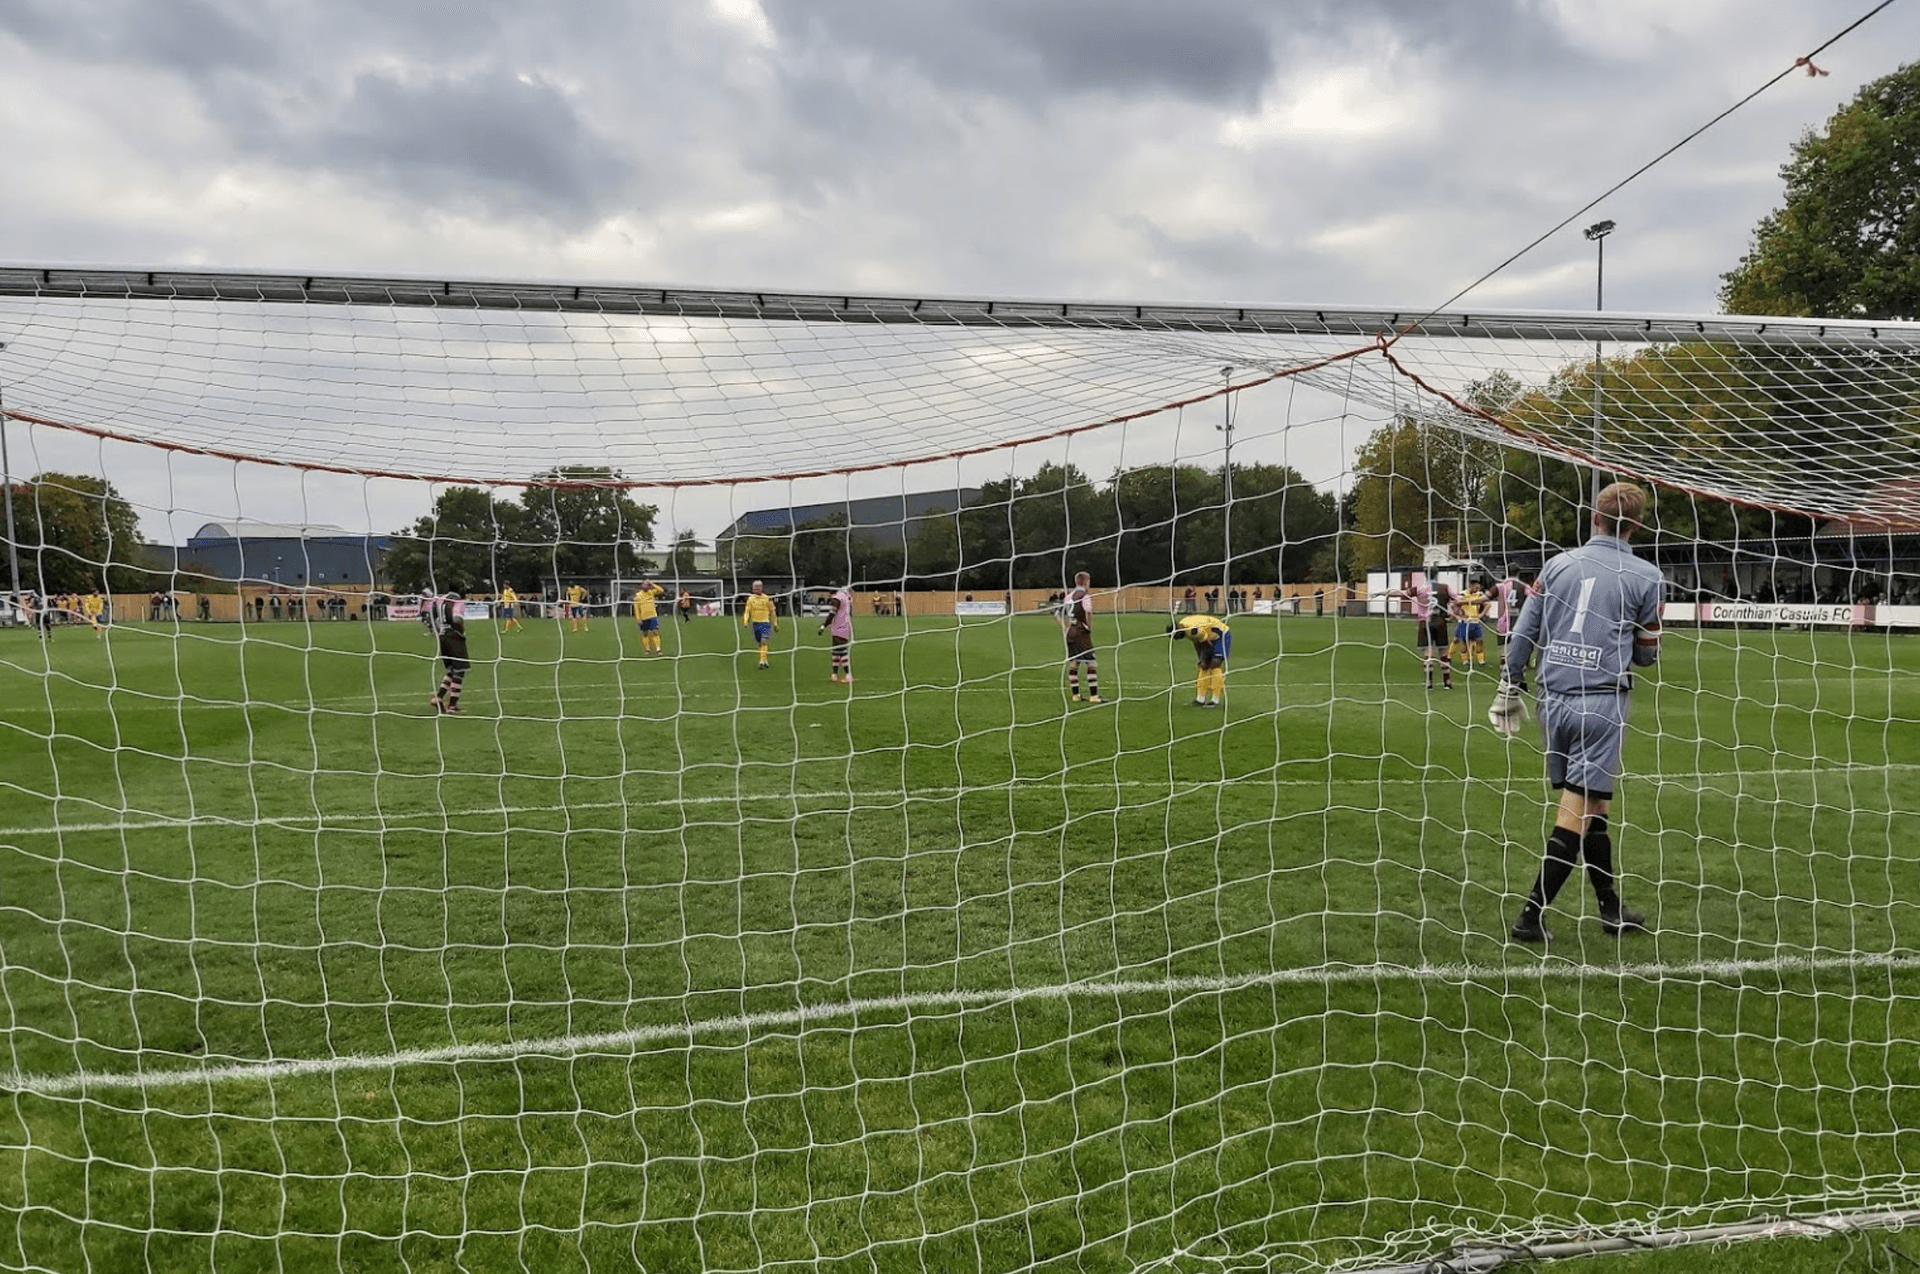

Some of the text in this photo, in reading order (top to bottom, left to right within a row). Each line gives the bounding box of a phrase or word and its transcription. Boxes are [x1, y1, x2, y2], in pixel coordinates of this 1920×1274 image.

[1507, 589, 1518, 606] 4
[1570, 577, 1596, 634] 1
[1832, 608, 1852, 621] FC
